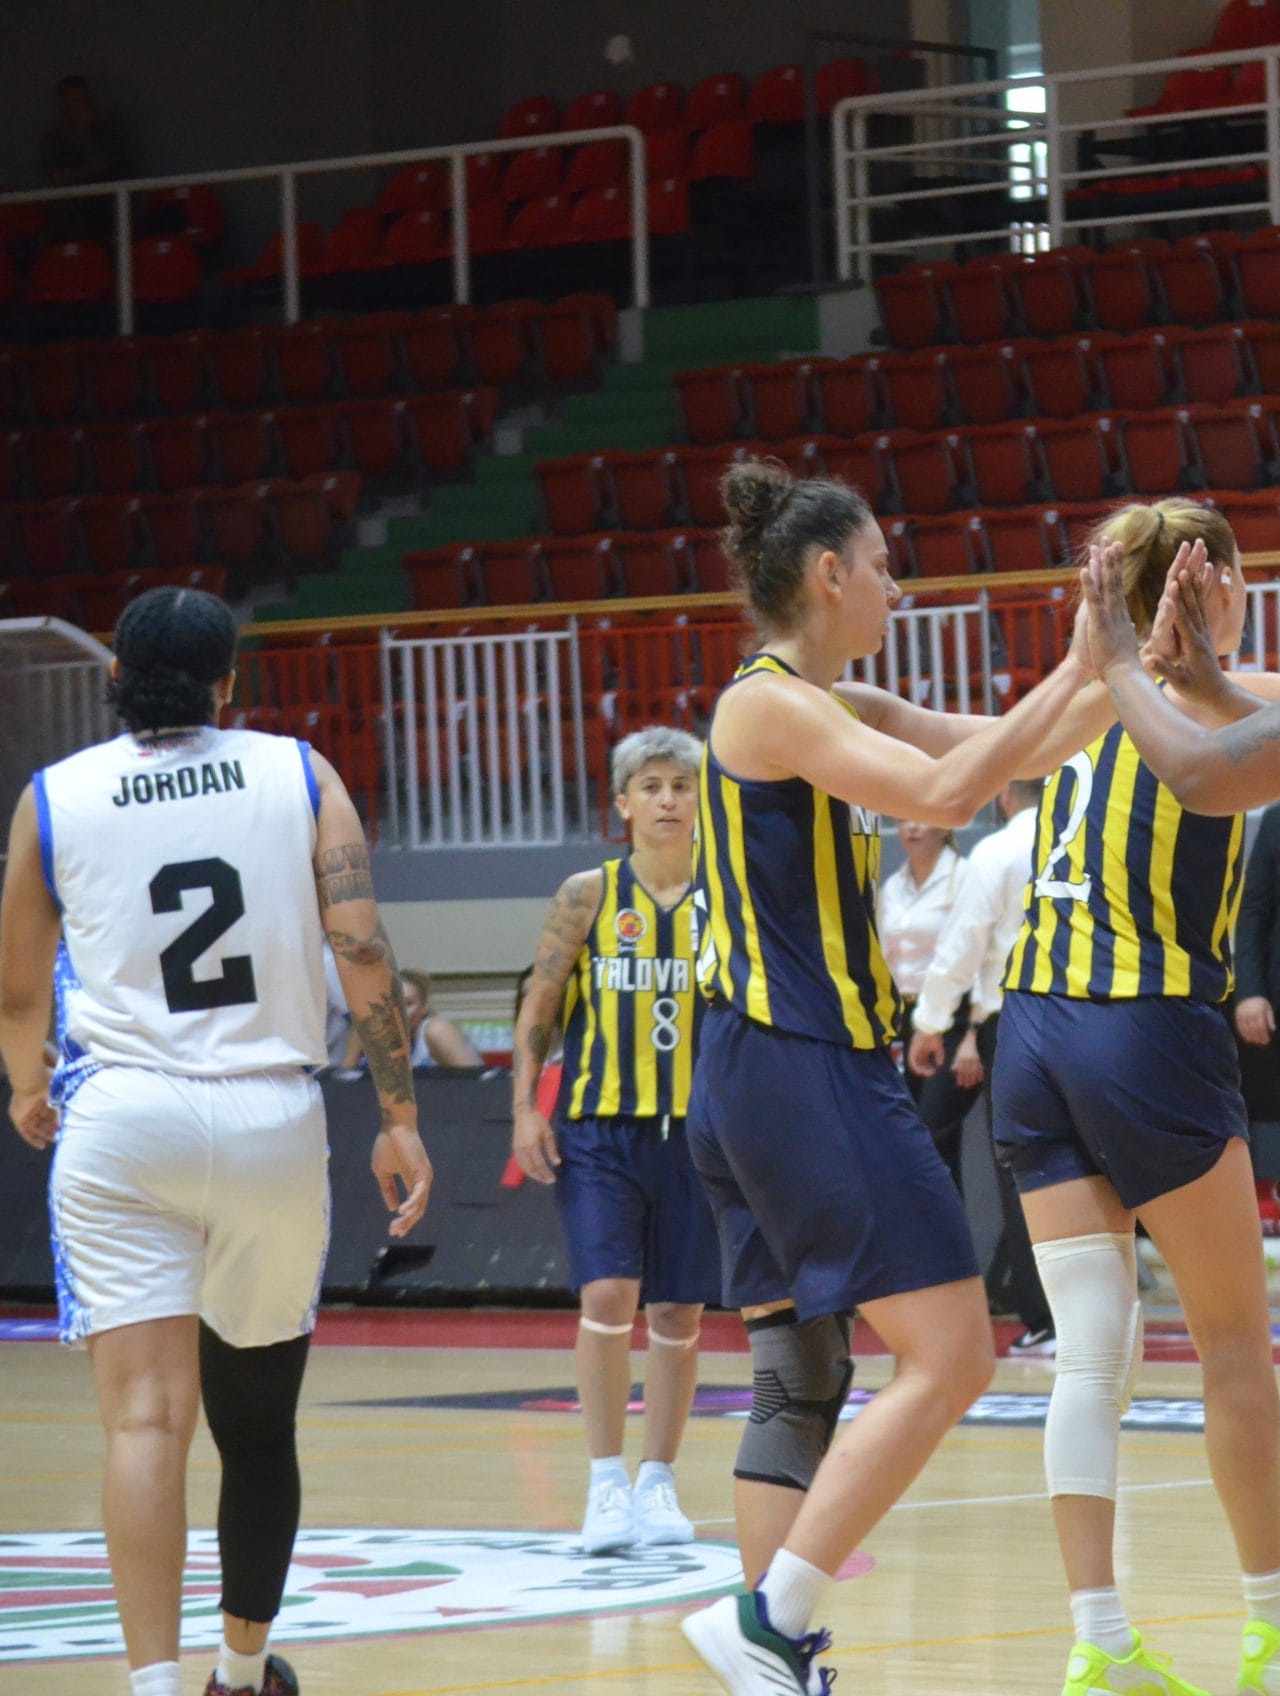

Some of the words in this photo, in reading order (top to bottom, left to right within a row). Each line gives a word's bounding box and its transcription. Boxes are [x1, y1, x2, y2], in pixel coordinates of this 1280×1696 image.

[112, 760, 246, 807] JORDAN
[1034, 751, 1094, 903] 2
[149, 857, 258, 1014] 2
[592, 957, 689, 992] YALOVA
[651, 998, 680, 1051] 8
